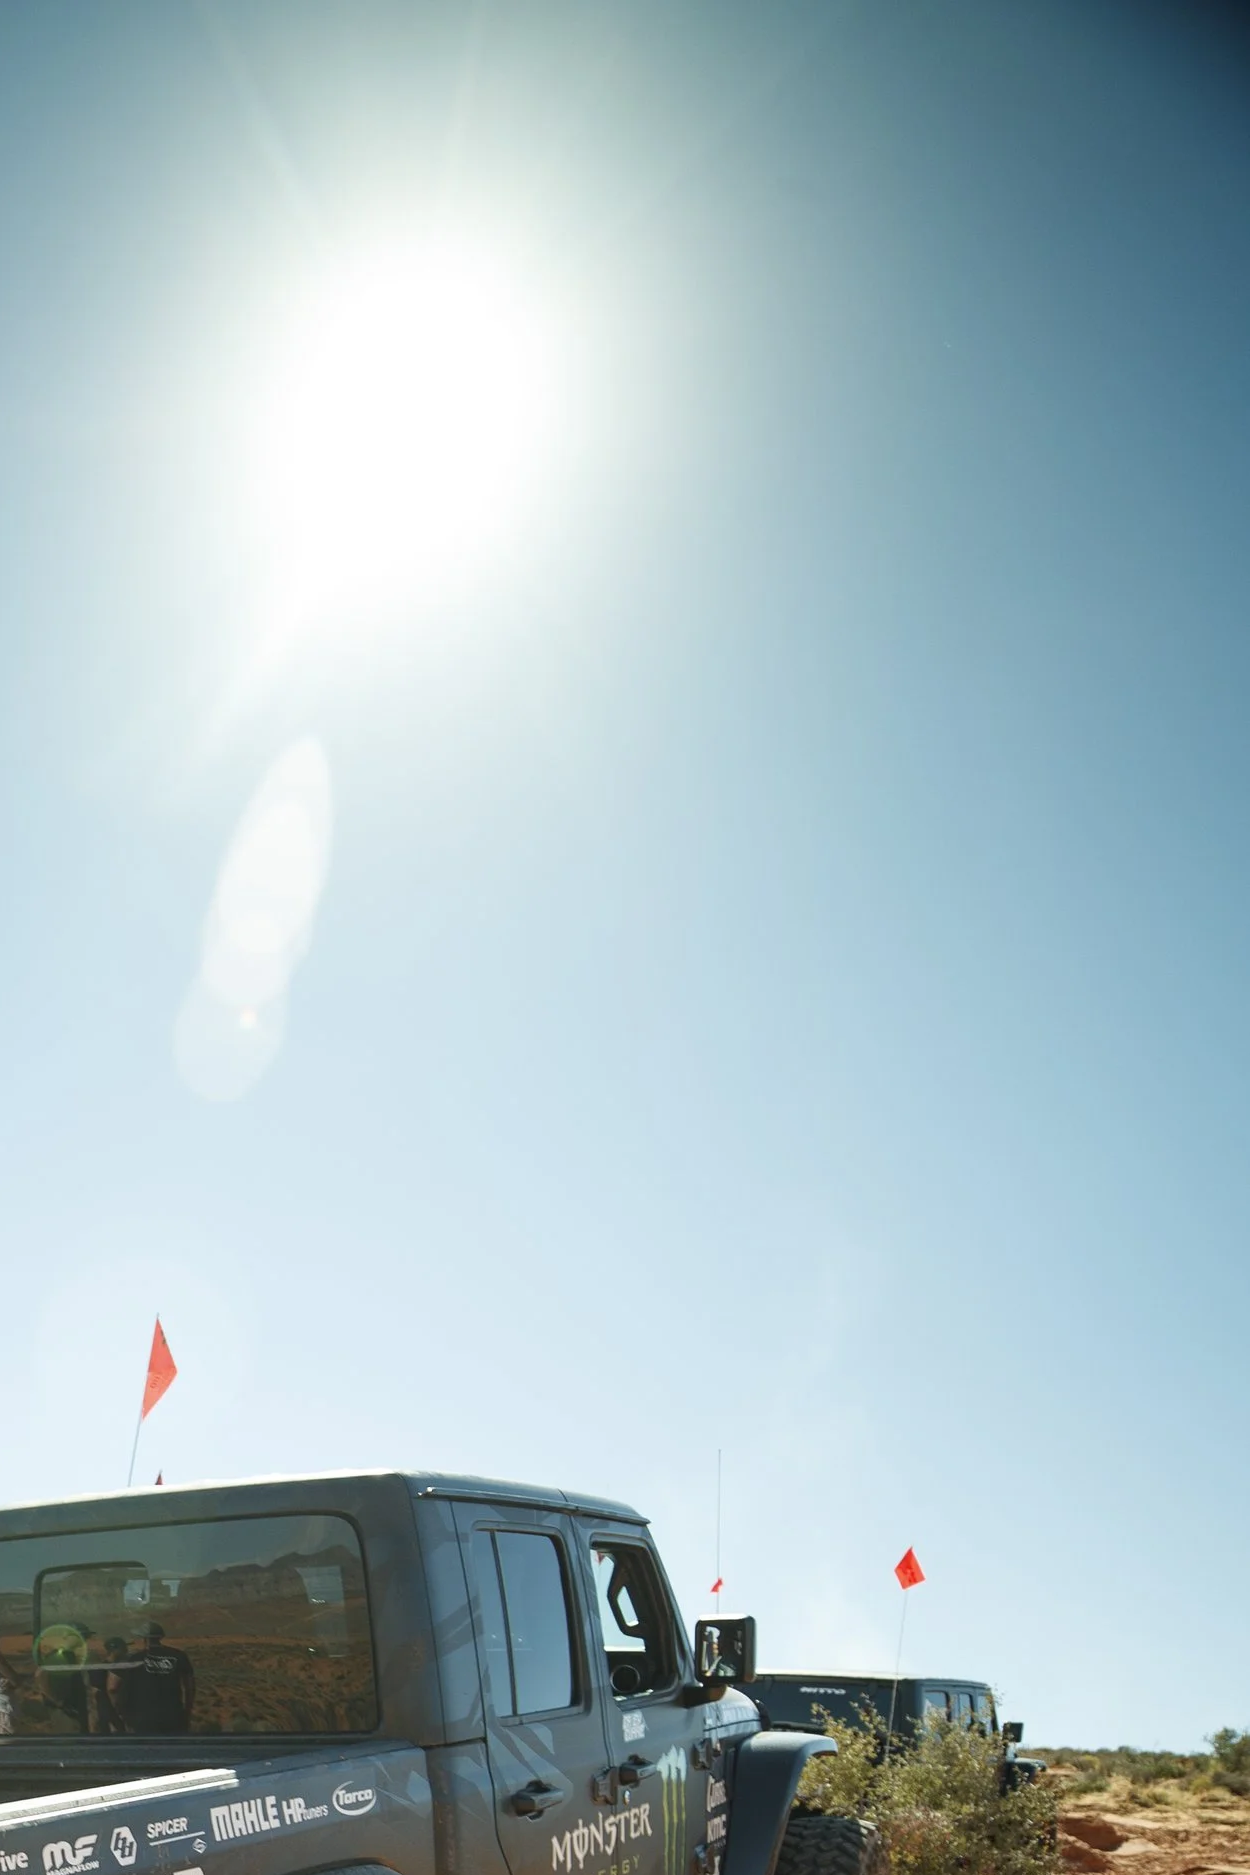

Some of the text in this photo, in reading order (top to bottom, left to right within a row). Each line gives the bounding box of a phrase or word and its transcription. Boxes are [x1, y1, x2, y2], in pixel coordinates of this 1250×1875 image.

[335, 1788, 374, 1806] Torco
[146, 1817, 189, 1839] SPICER
[210, 1795, 281, 1842] MAHLE
[551, 1803, 653, 1873] MONSTER
